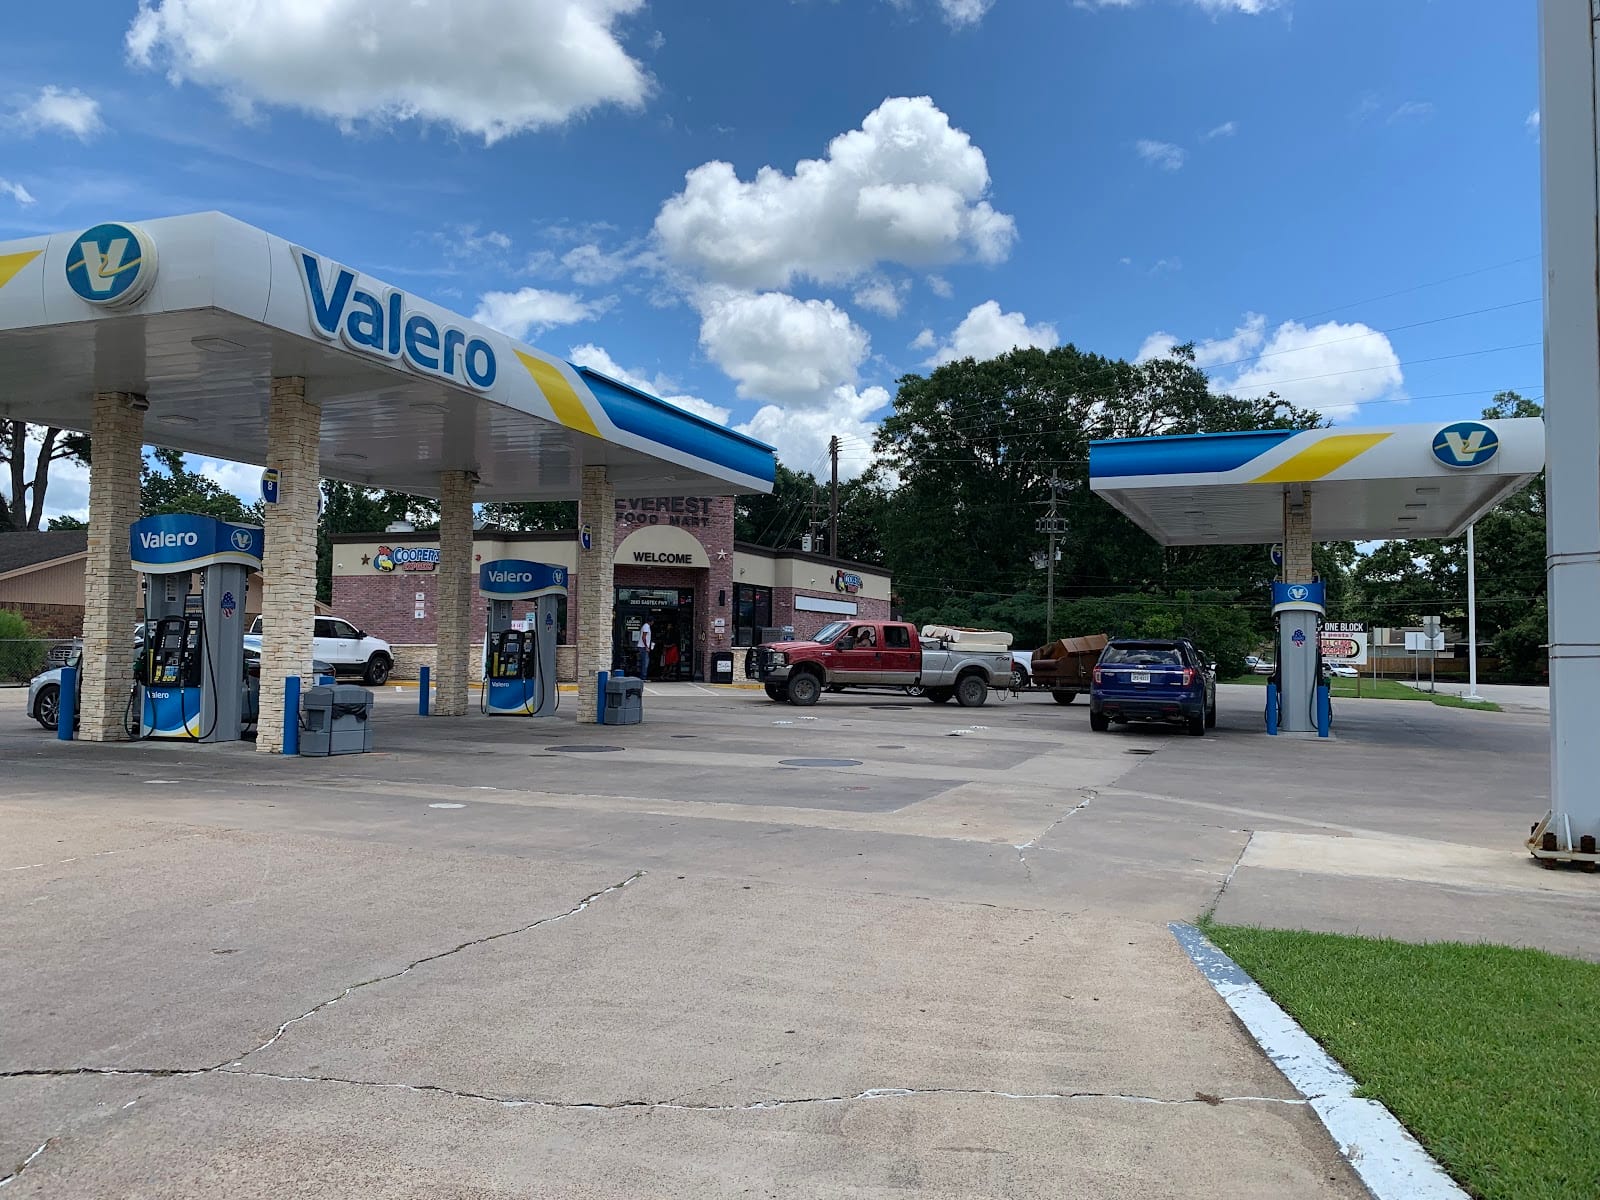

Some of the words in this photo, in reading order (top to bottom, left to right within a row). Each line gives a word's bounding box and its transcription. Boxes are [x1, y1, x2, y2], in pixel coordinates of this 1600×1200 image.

[302, 253, 497, 388] Valero
[614, 496, 712, 514] EVEREST
[615, 512, 658, 524] FOOD
[140, 530, 198, 549] Valero
[633, 551, 693, 564] WELCOME
[488, 570, 533, 583] Valero
[1324, 622, 1340, 632] ONE
[1340, 622, 1364, 632] BLOCK
[147, 690, 170, 699] Valero
